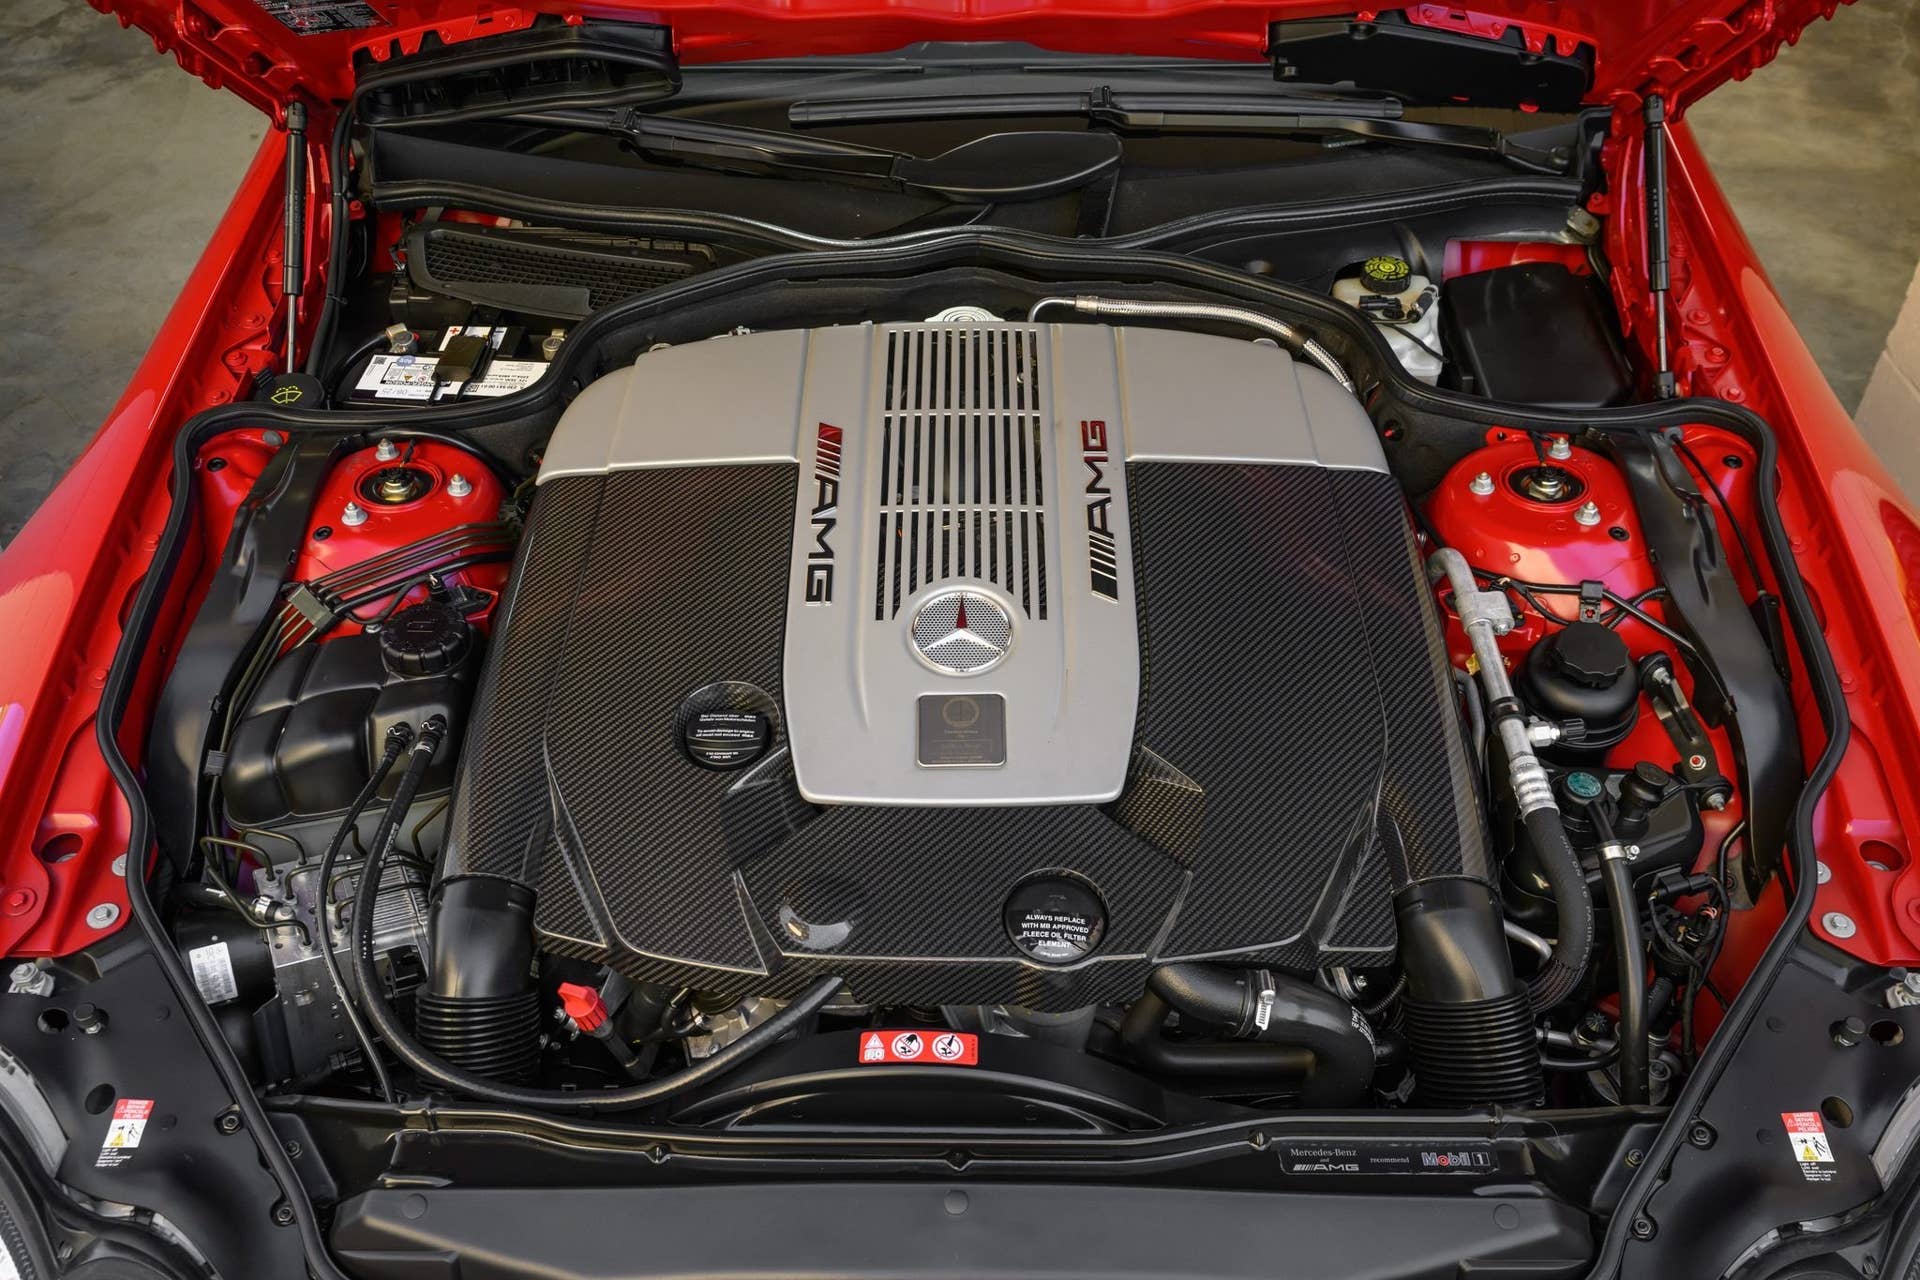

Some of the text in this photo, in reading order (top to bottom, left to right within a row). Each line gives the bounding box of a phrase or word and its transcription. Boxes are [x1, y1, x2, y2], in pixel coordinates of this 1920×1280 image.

[1080, 420, 1115, 541] AMG
[805, 473, 839, 606] AMG
[1025, 914, 1086, 925] ALWAYS REPLACE
[1052, 923, 1089, 934] APPROVED
[1022, 930, 1087, 942] FLEECE OIL FILTER
[1290, 1148, 1359, 1157] Mercedes-Benz
[1370, 1156, 1410, 1164] recommend
[1421, 1152, 1471, 1167] Mobil
[1312, 1163, 1360, 1171] AMG
